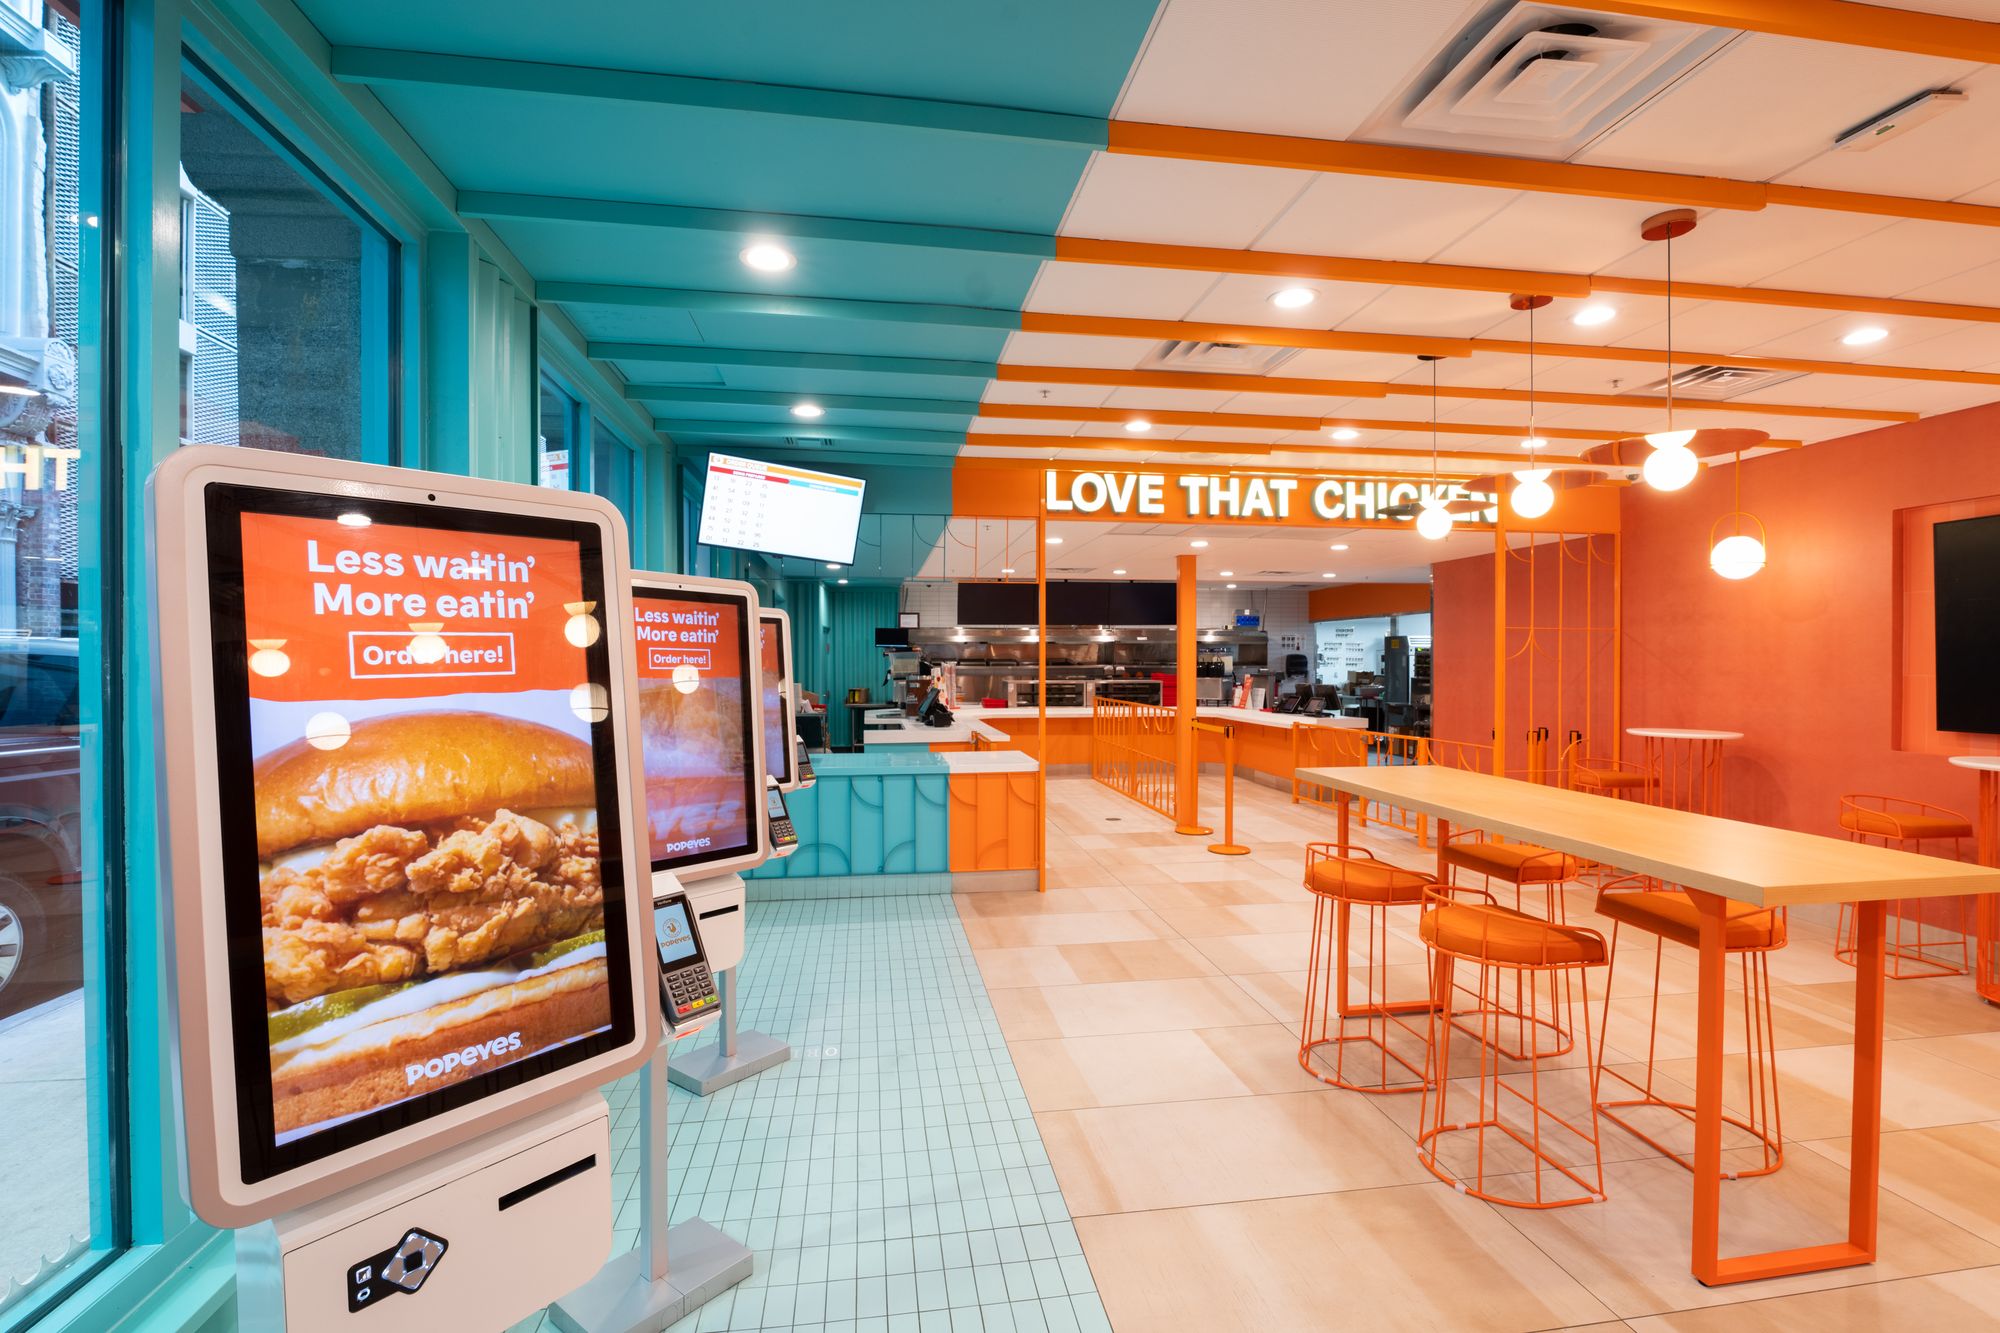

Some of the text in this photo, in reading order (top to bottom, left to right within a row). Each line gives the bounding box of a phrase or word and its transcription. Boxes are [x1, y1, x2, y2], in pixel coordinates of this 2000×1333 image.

[1046, 471, 1165, 514] LOVE
[1179, 476, 1298, 518] THAT
[307, 540, 535, 583] Less waitin'
[313, 582, 535, 619] More eatin'
[634, 607, 719, 626] Less waitin'
[637, 626, 719, 643] More eatin'
[363, 645, 504, 665] Ord here!
[653, 654, 706, 664] Order here!
